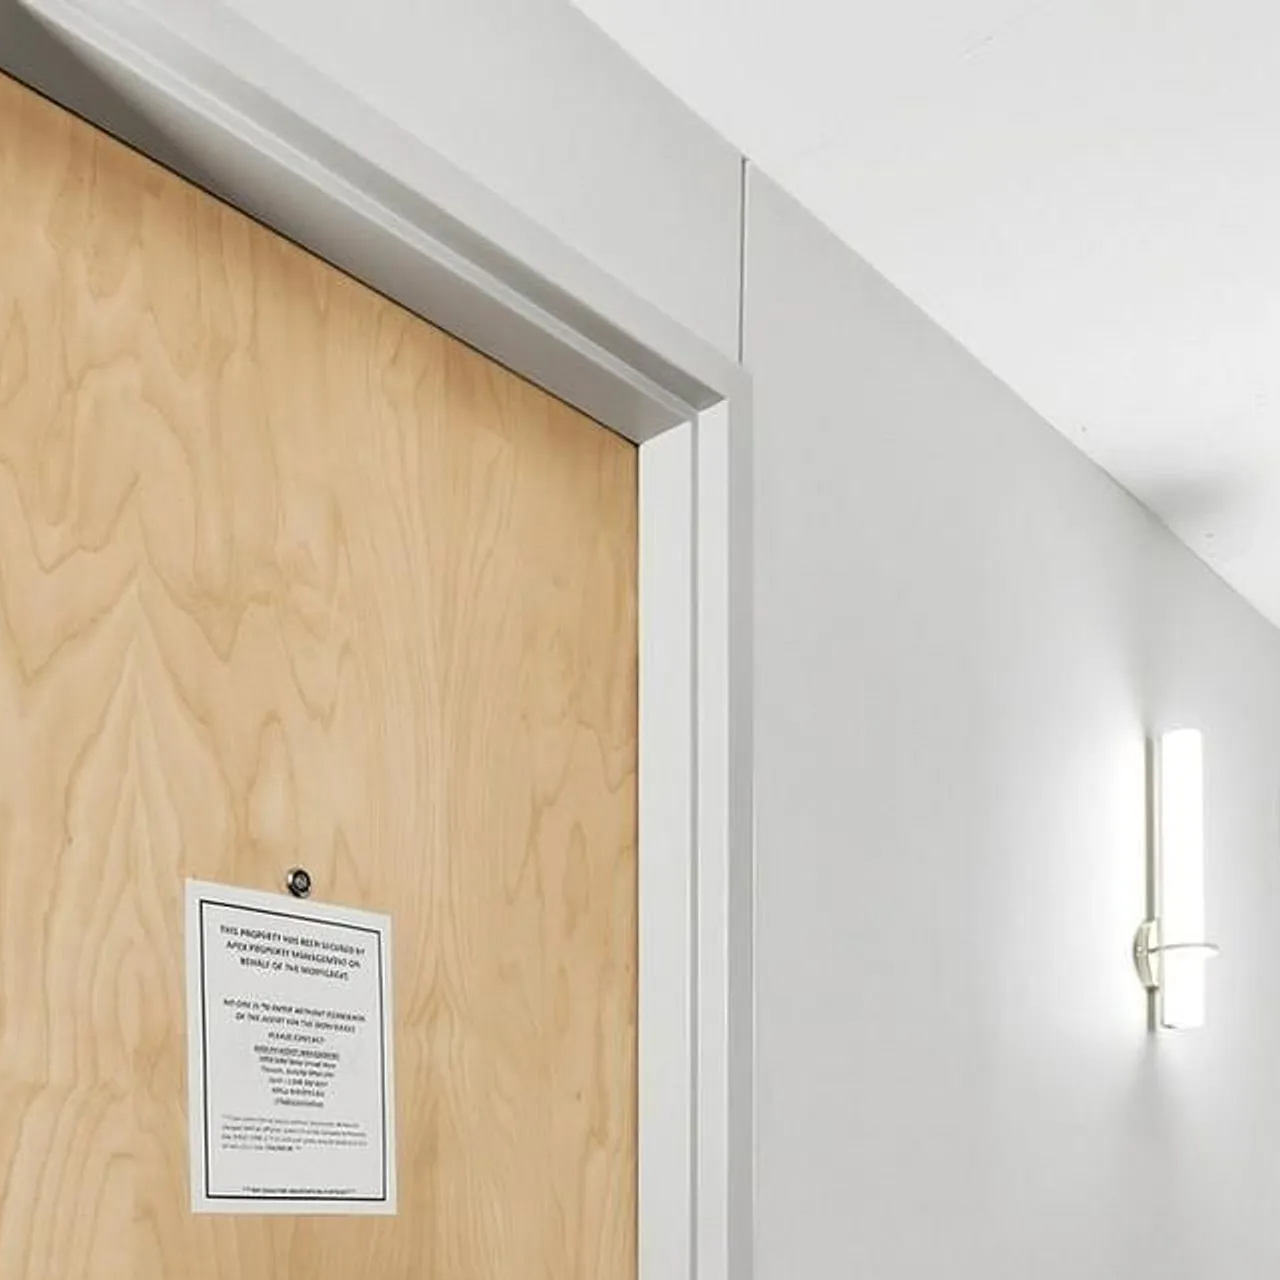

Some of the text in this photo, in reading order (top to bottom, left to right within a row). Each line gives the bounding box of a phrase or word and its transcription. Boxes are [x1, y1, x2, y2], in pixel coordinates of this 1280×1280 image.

[240, 927, 281, 942] PROPERTY
[300, 937, 319, 948] BEEN
[248, 943, 289, 957] PROPERTY
[240, 956, 269, 969] BEHALF
[285, 963, 299, 973] THE
